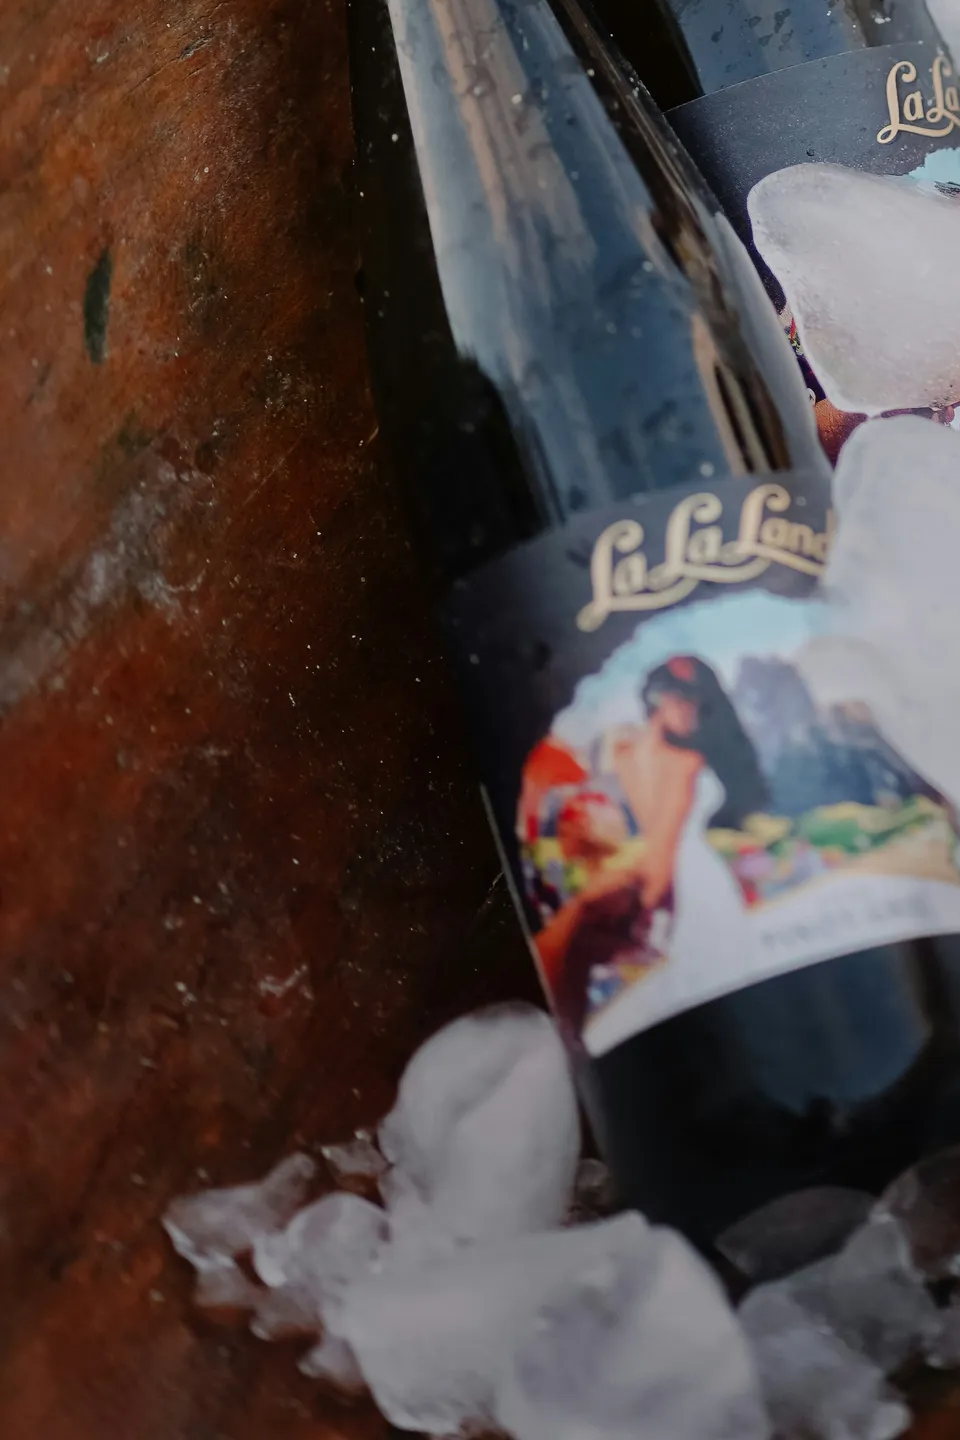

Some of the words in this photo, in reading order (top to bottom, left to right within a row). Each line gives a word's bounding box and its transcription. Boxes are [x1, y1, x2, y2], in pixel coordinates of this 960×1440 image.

[876, 60, 955, 145] La
[575, 518, 701, 633] La
[646, 491, 772, 584] La
